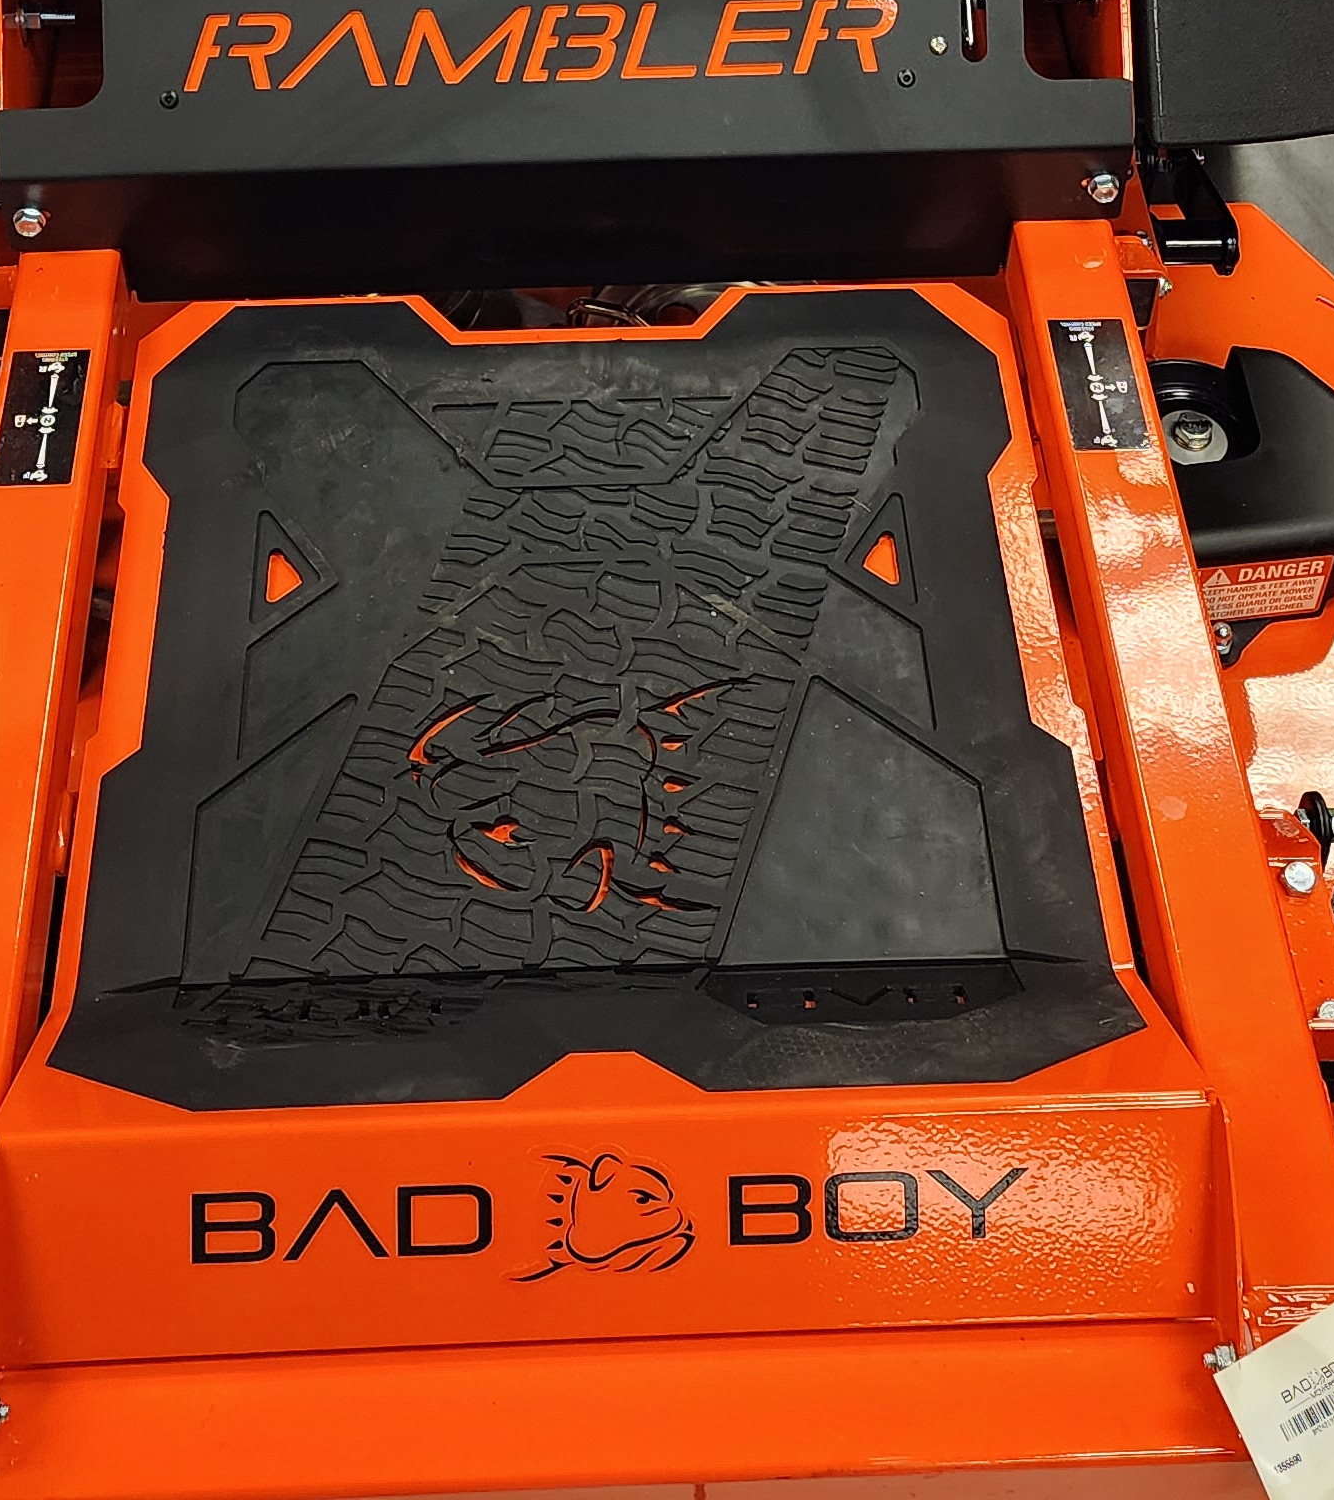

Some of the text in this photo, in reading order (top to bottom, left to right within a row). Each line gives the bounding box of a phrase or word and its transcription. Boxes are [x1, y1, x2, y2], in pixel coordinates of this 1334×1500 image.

[1238, 560, 1325, 582] DANGER
[1227, 584, 1258, 594] HANDS
[1268, 581, 1290, 590] FEET
[1238, 591, 1277, 601] OPERATE
[1280, 586, 1315, 595] MOWER
[1235, 600, 1267, 609] GUARD
[1268, 597, 1282, 605] OR
[1284, 594, 1315, 602] GRASS
[1210, 609, 1245, 618] ATCHER
[189, 1166, 1030, 1266] BAD BOY
[1280, 1378, 1313, 1404] BAD
